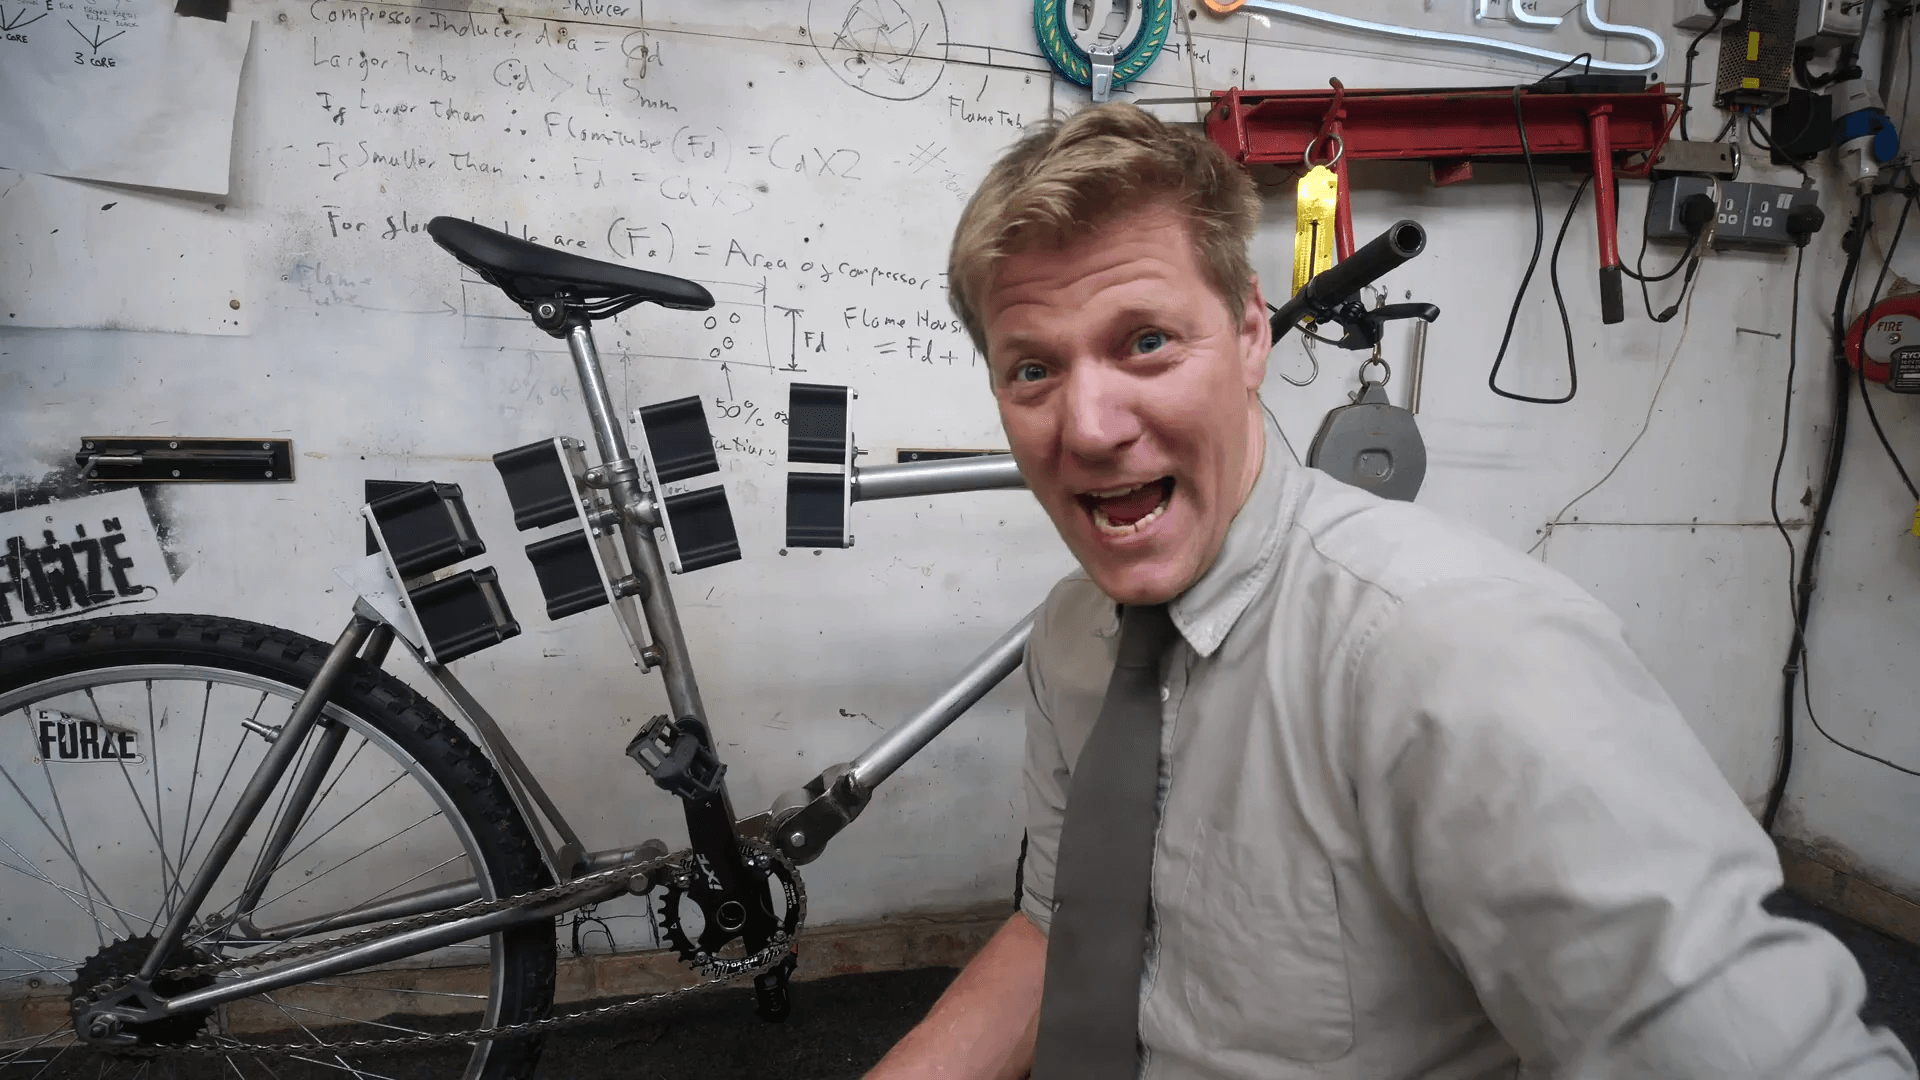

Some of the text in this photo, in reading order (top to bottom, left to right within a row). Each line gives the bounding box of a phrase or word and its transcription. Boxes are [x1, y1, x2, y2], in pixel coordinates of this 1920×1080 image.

[6, 33, 28, 43] CORE
[74, 52, 116, 67] 3 CORE
[322, 205, 367, 238] For
[553, 235, 587, 249] are
[725, 239, 788, 268] Area
[844, 306, 906, 329] Flame
[1877, 321, 1904, 332] FIRE
[804, 331, 827, 353] Fd
